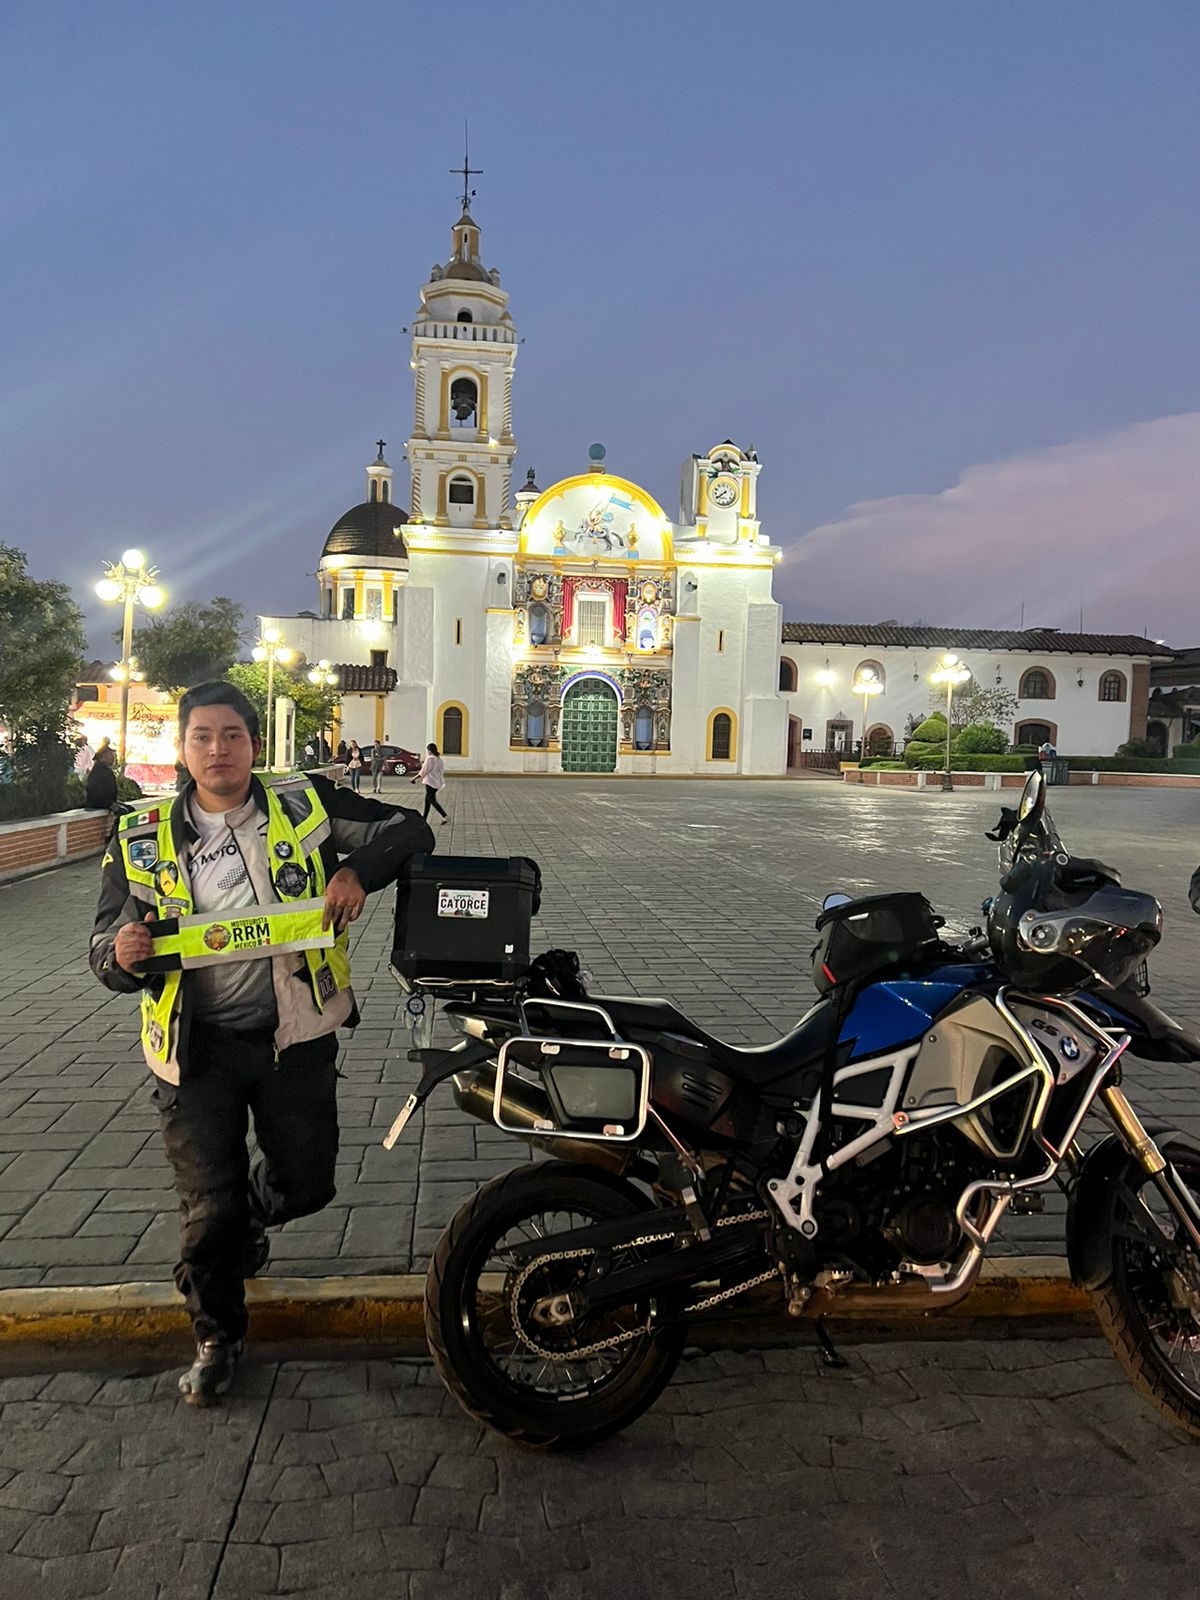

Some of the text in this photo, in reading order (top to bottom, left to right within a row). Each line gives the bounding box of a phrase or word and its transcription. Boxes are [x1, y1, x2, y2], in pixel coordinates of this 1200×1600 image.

[88, 711, 115, 719] PIZZAS
[440, 898, 487, 910] CATORCE
[231, 917, 267, 927] MOTOTURISTA
[232, 922, 270, 942] RRM
[1031, 1018, 1060, 1036] GS
